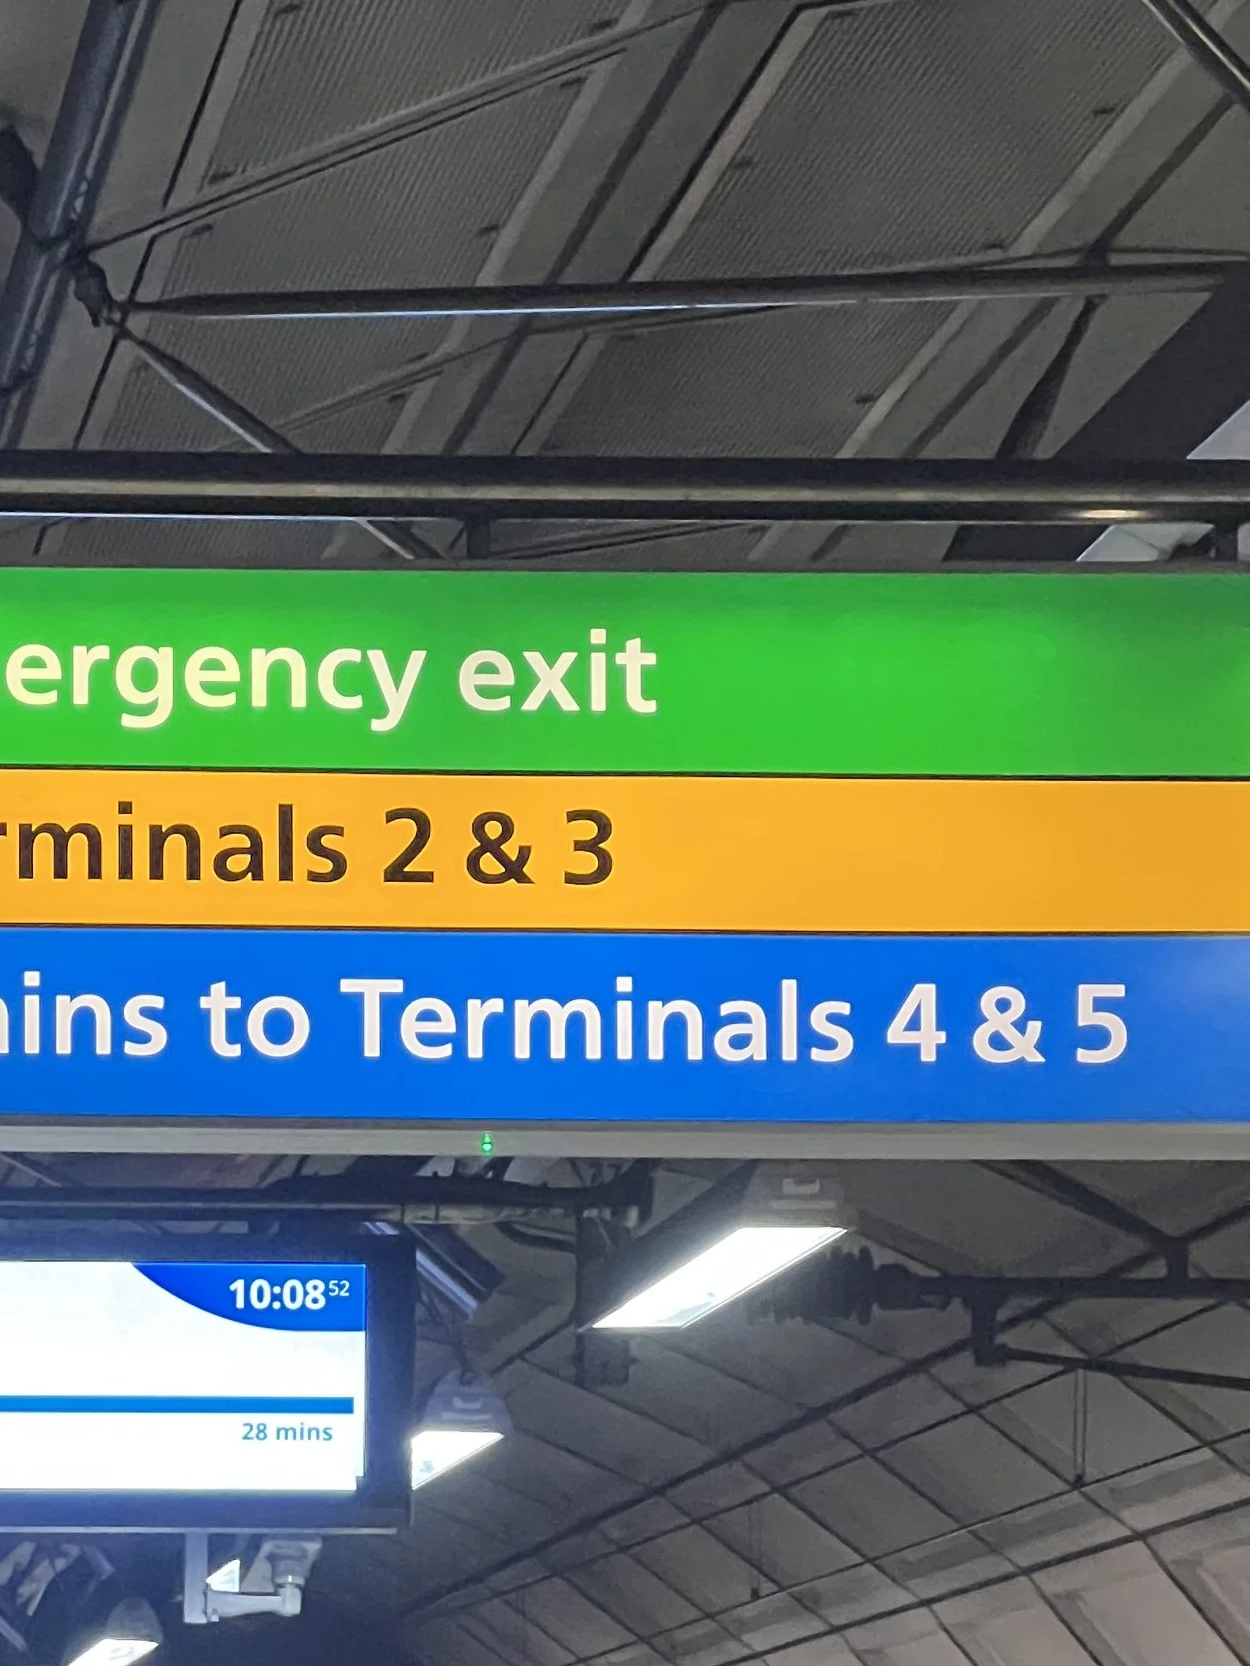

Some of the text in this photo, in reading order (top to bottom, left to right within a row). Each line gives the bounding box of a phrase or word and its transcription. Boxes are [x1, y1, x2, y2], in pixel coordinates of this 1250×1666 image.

[460, 629, 657, 712] exit
[384, 808, 434, 882] 2
[467, 812, 534, 884] &
[565, 810, 613, 885] 3
[200, 982, 309, 1056] to
[340, 977, 853, 1062] Terminals
[887, 984, 945, 1061] 4
[973, 987, 1045, 1063] &
[1076, 985, 1127, 1063] 5
[241, 1421, 333, 1442] 28 mins
